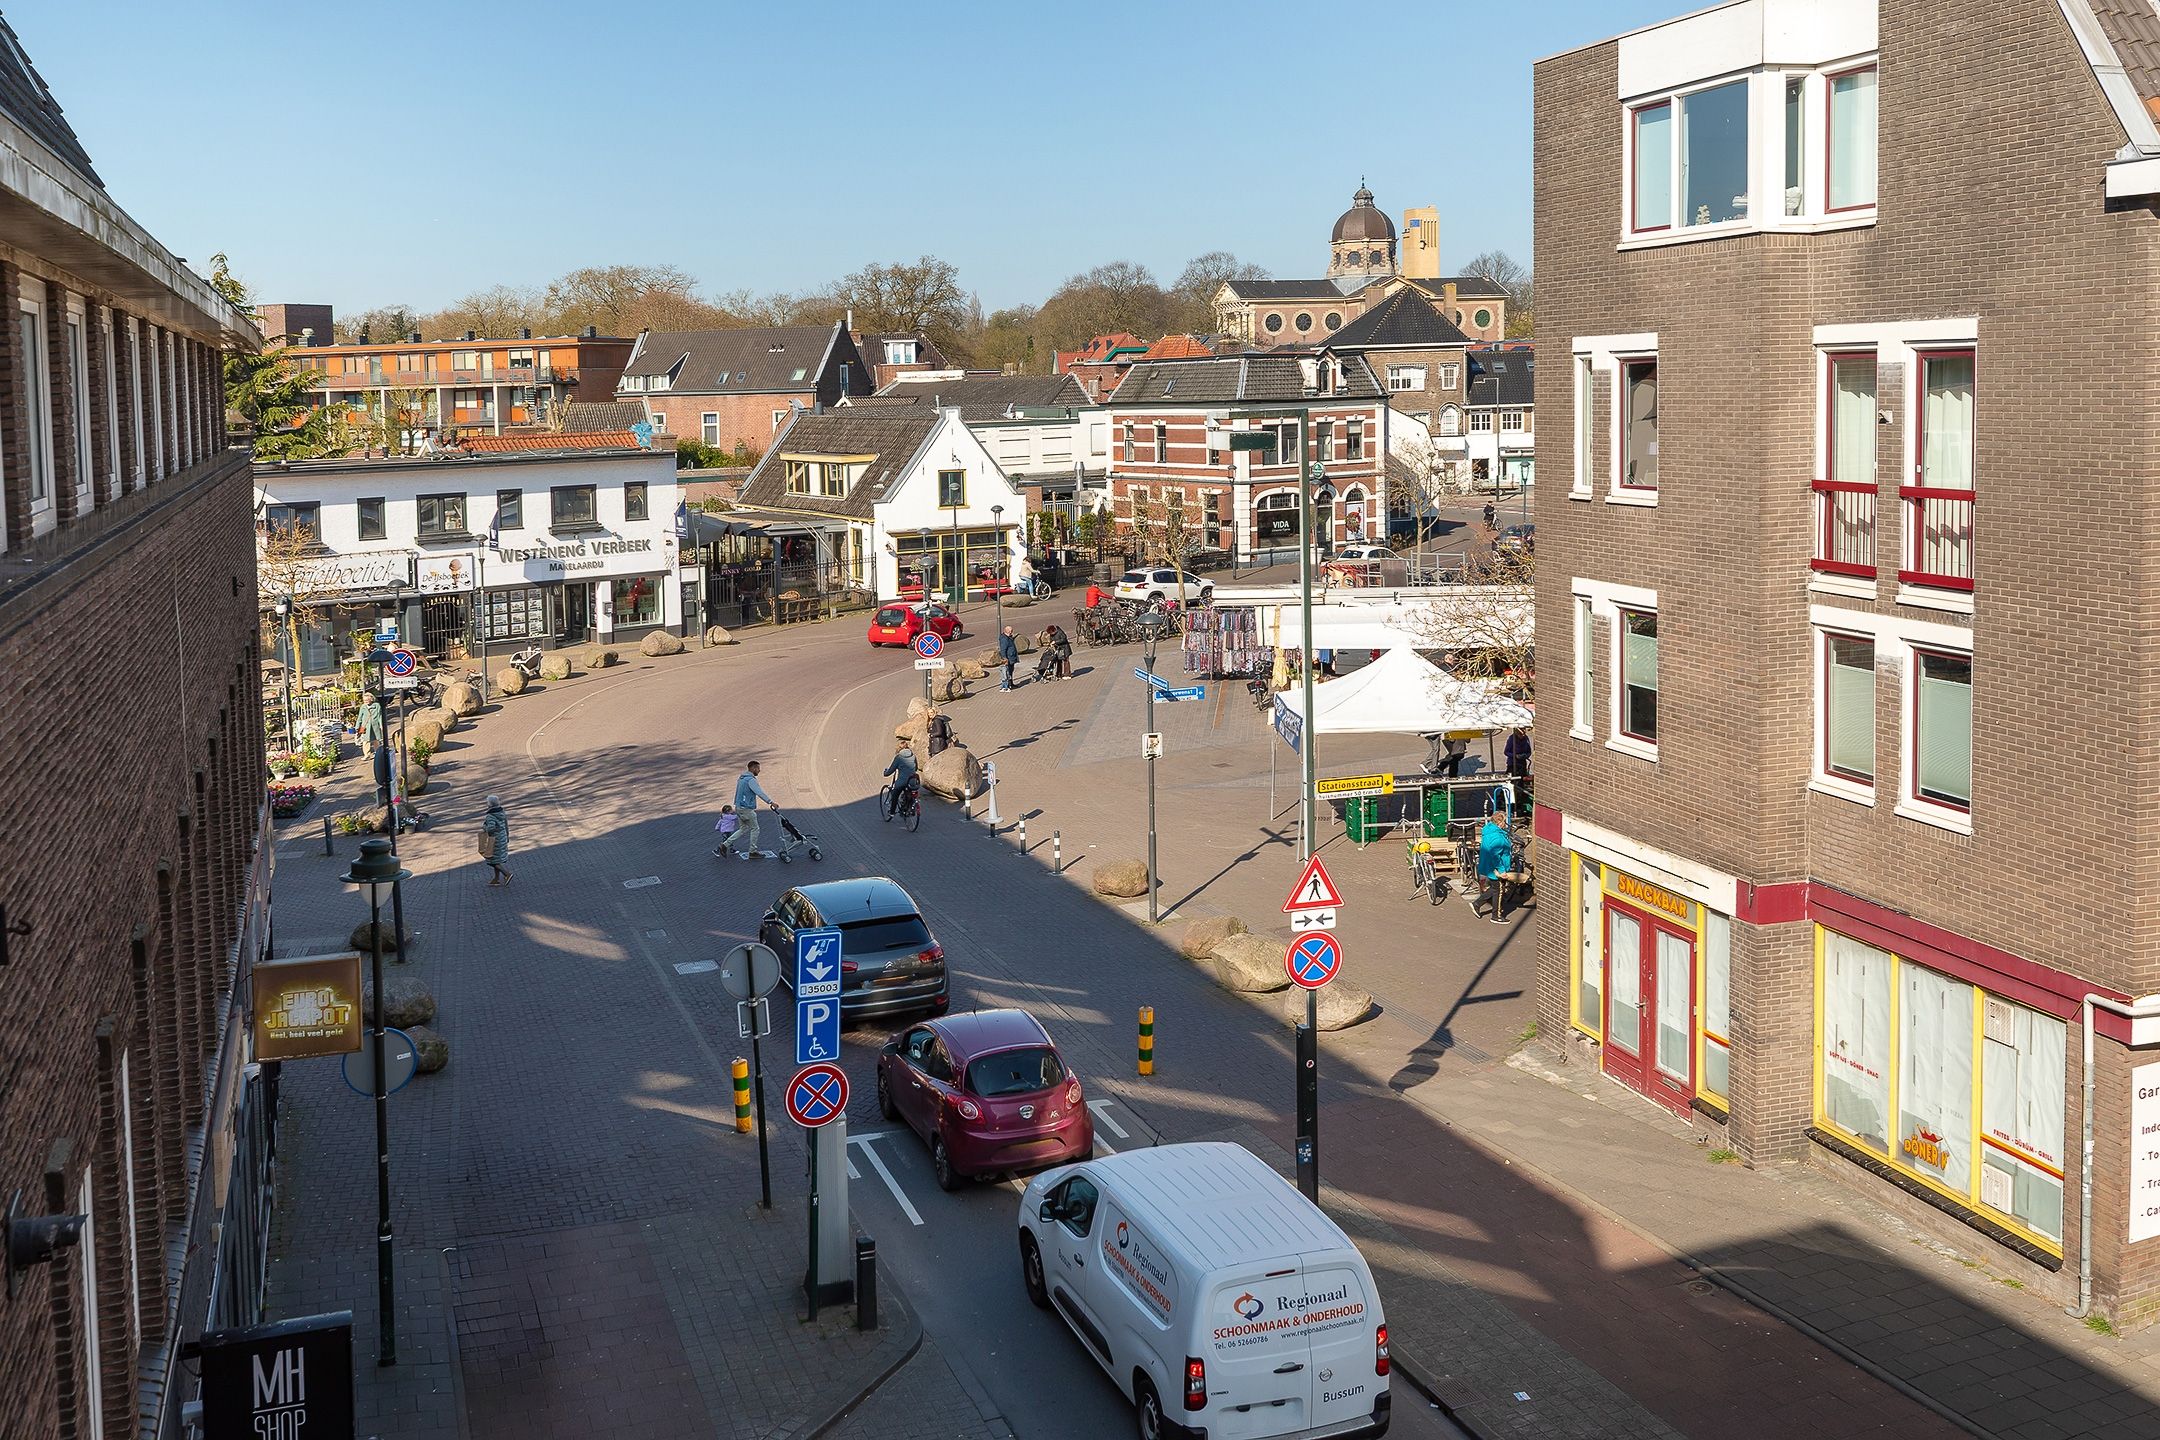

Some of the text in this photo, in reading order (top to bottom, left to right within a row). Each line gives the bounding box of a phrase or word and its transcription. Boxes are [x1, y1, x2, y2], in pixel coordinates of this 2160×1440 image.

[1272, 520, 1290, 529] VIDA
[499, 544, 586, 564] WESTENENG
[591, 538, 652, 556] VERBEEK
[1321, 779, 1380, 791] Stationsstraat
[1618, 873, 1688, 919] SNACKBAR
[281, 989, 331, 1010] EURO
[807, 983, 838, 995] 35003
[307, 1029, 323, 1037] veel
[807, 1002, 831, 1036] P
[2138, 1086, 2160, 1100] Gar
[1903, 1135, 1939, 1168] DÖNER
[1103, 1239, 1136, 1277] SCHOONMAAK
[1140, 1274, 1171, 1313] ONDERHOUD
[1132, 1242, 1168, 1286] Regionaal
[1277, 1284, 1348, 1312] Regionaal
[1213, 1303, 1364, 1340] SCHOONMAAK & ONDERHOUD
[1214, 1316, 1365, 1351] Tel. 06 52660786 www.regionaalschoonmaak.nl
[252, 1346, 306, 1409] MH
[1323, 1384, 1365, 1403] Bussum
